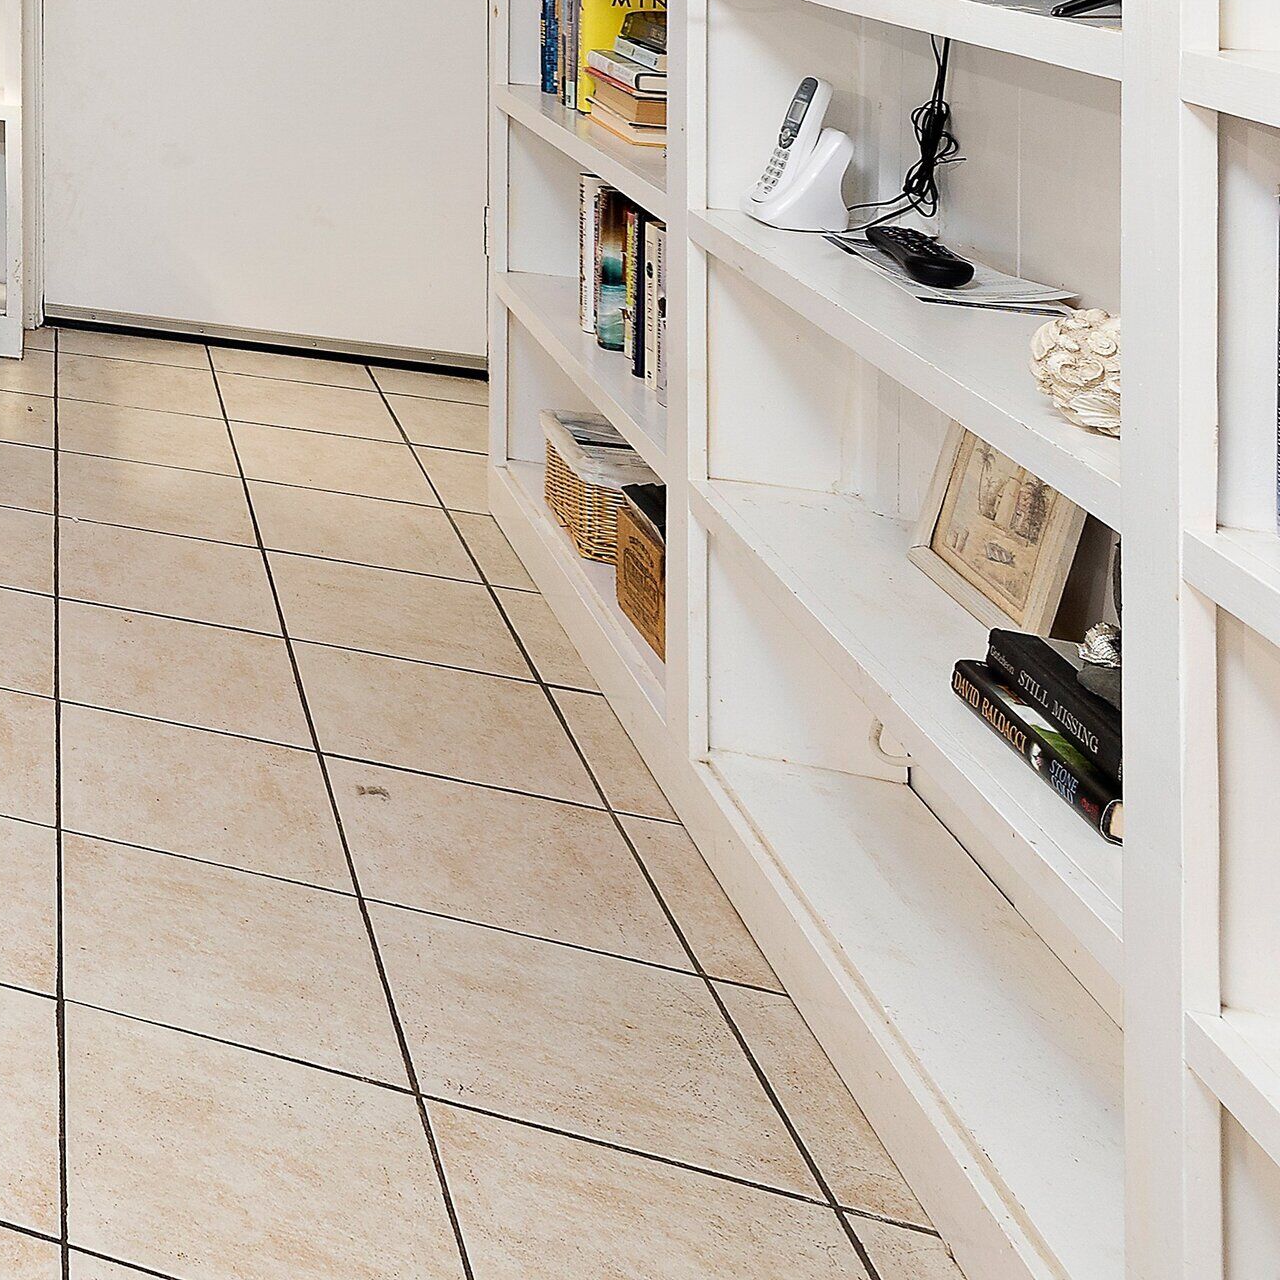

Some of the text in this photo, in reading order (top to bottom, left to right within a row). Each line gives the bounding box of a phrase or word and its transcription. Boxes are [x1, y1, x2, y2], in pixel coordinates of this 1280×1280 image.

[953, 671, 1028, 754] DAVID BALDACCI
[1017, 669, 1100, 754] STILL MISSING
[1049, 759, 1080, 795] STONE
